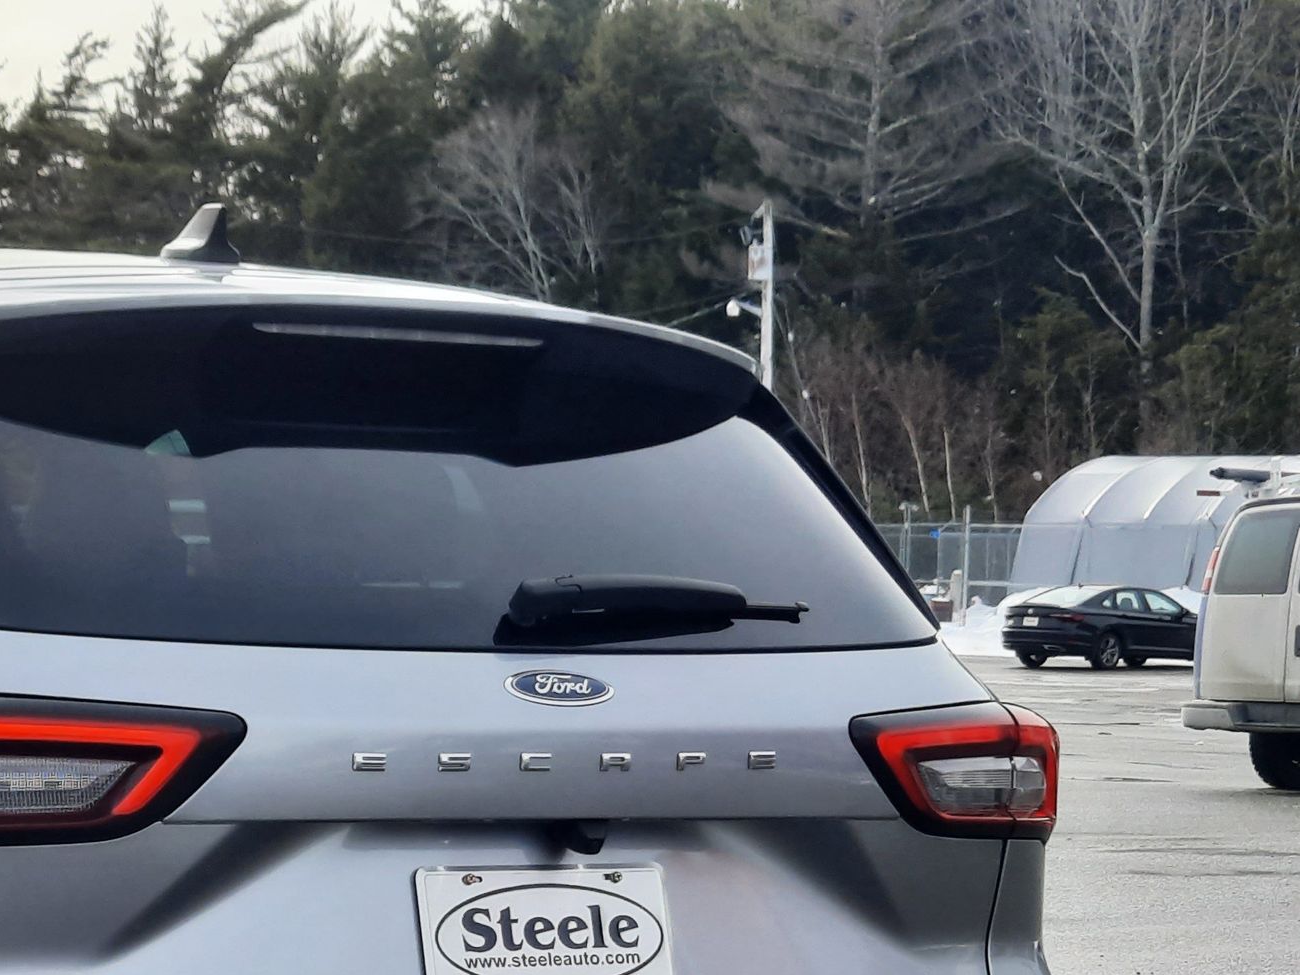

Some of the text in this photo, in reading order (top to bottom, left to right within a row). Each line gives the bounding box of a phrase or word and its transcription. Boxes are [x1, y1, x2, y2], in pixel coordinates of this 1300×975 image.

[535, 672, 592, 696] Ford
[352, 750, 778, 772] ESCAPE
[461, 904, 640, 952] Steele
[464, 951, 641, 969] www.steeleauto.com
